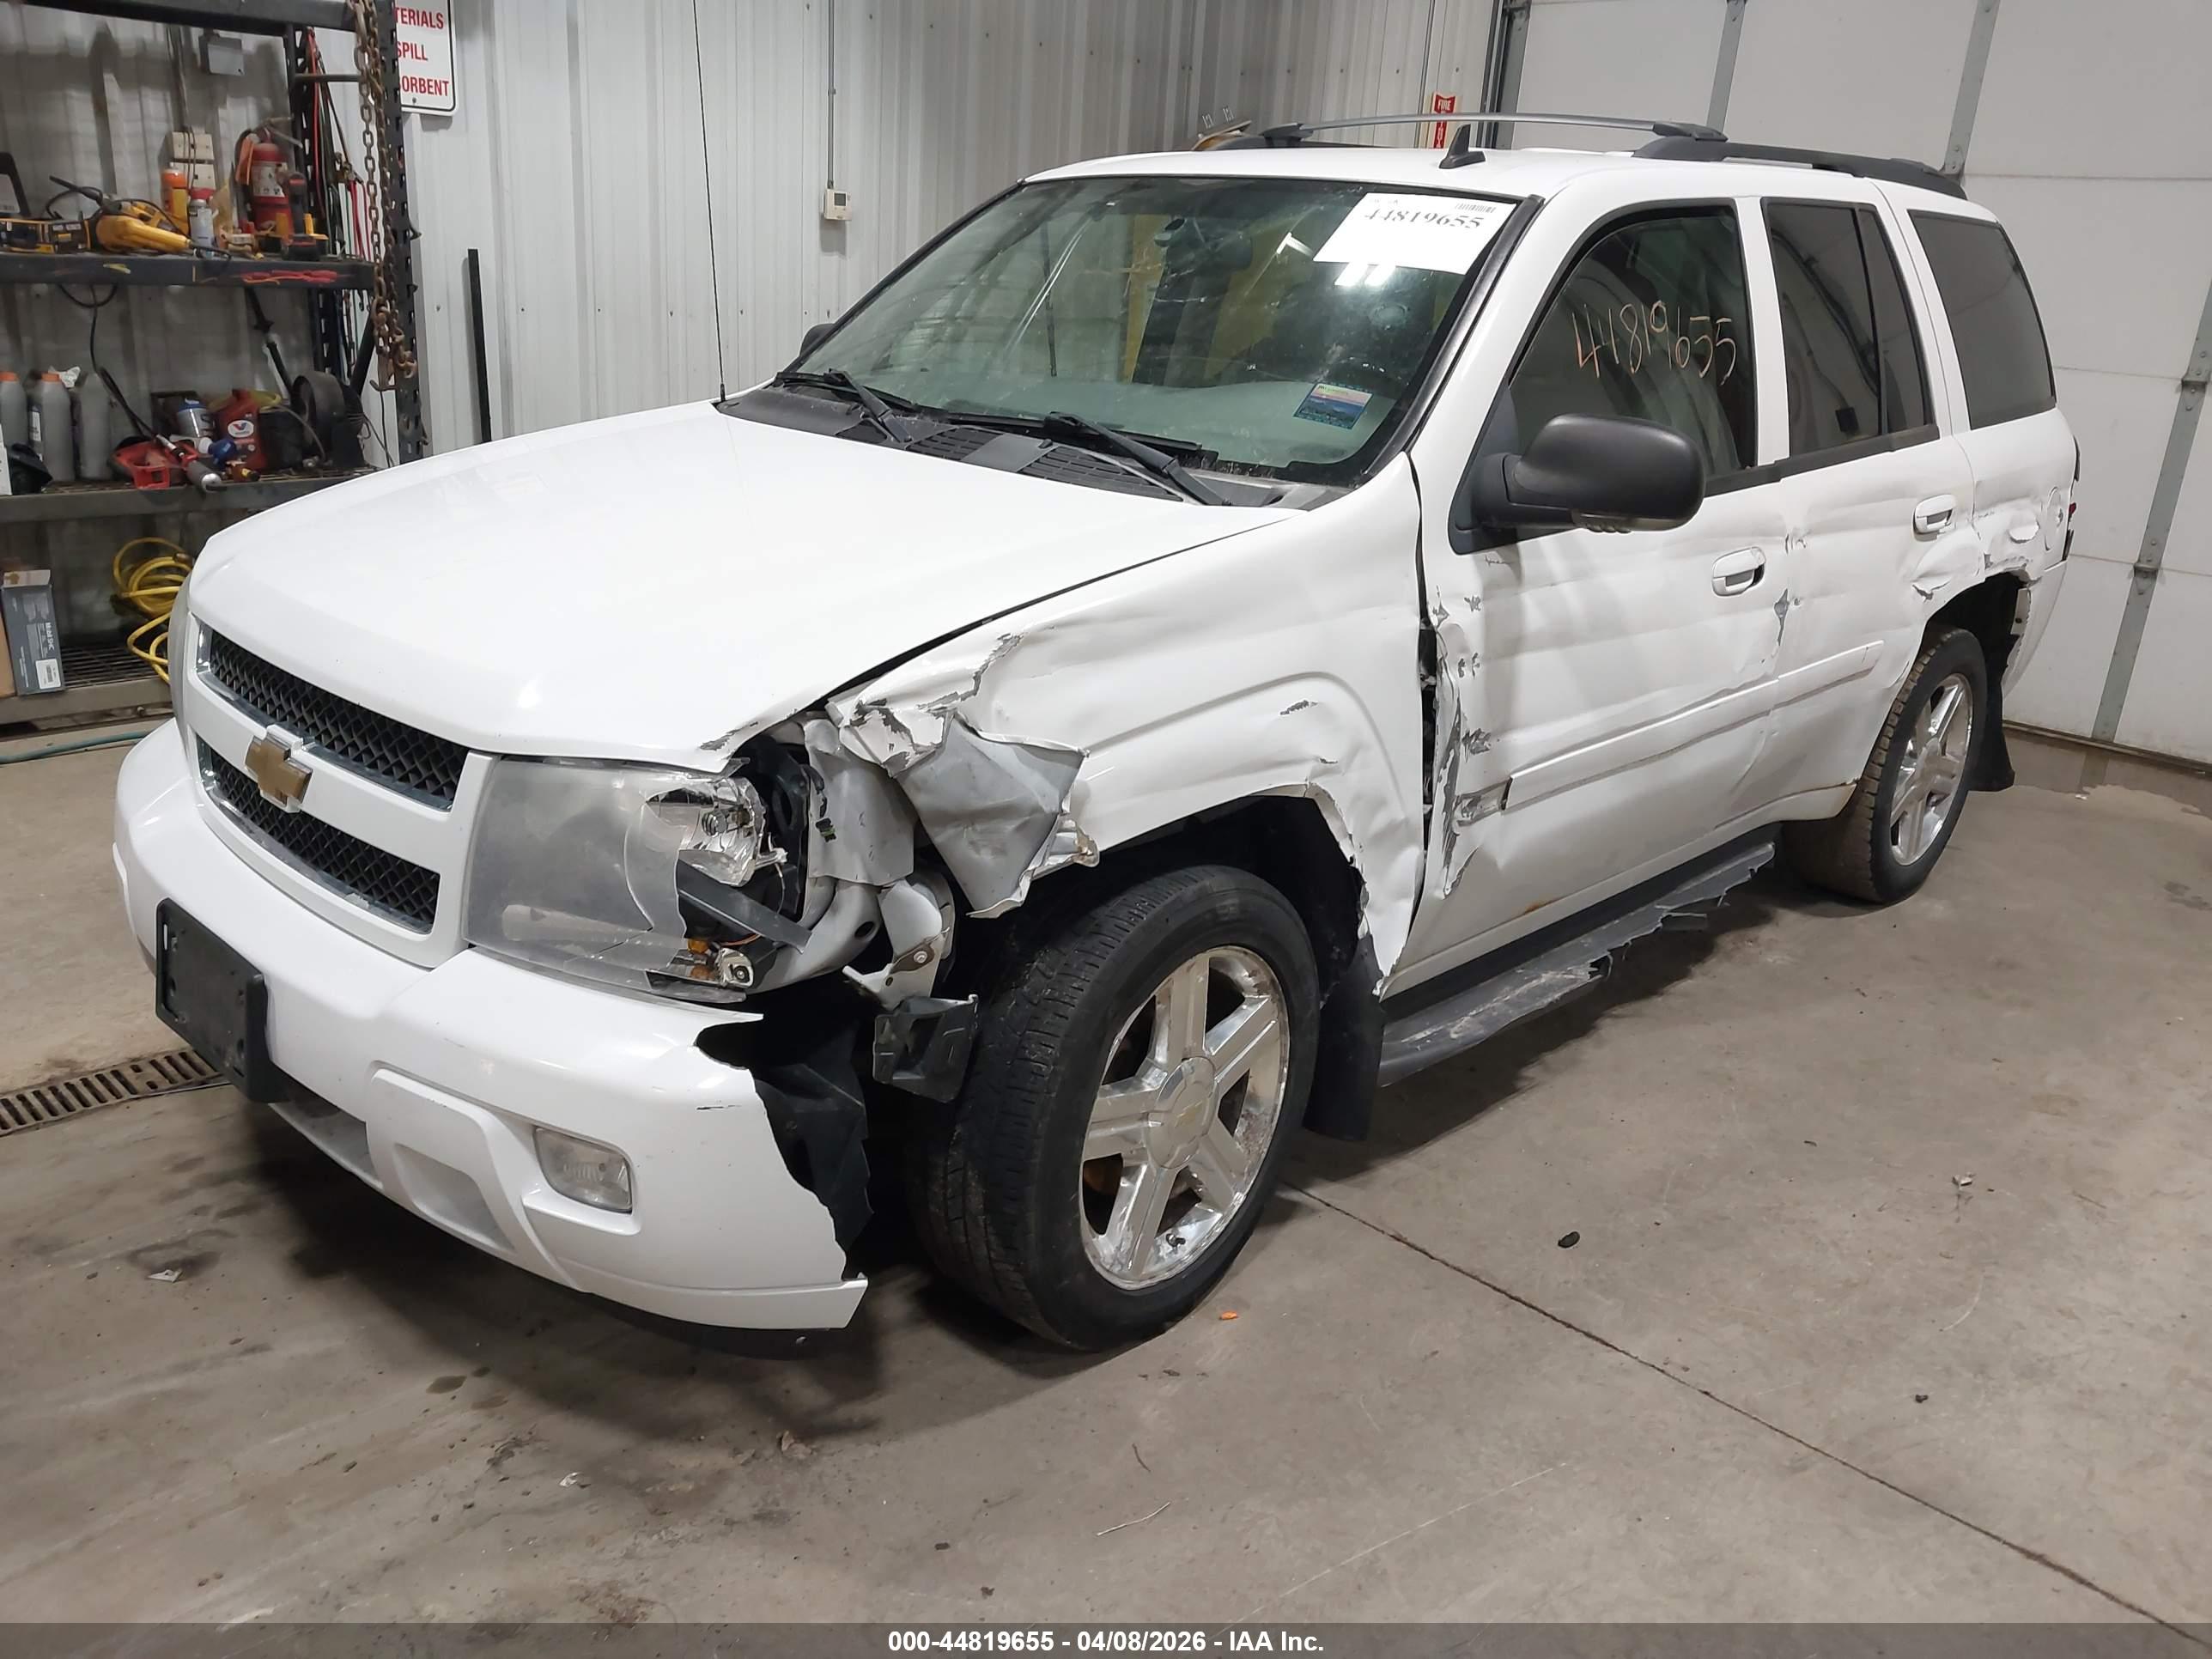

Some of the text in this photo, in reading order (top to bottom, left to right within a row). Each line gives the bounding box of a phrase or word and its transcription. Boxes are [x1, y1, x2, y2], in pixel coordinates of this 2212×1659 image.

[398, 75, 449, 96] ORBENT
[1437, 99, 1452, 111] FIRE
[1364, 208, 1485, 229] 44819655
[1571, 300, 1737, 386] 44819655
